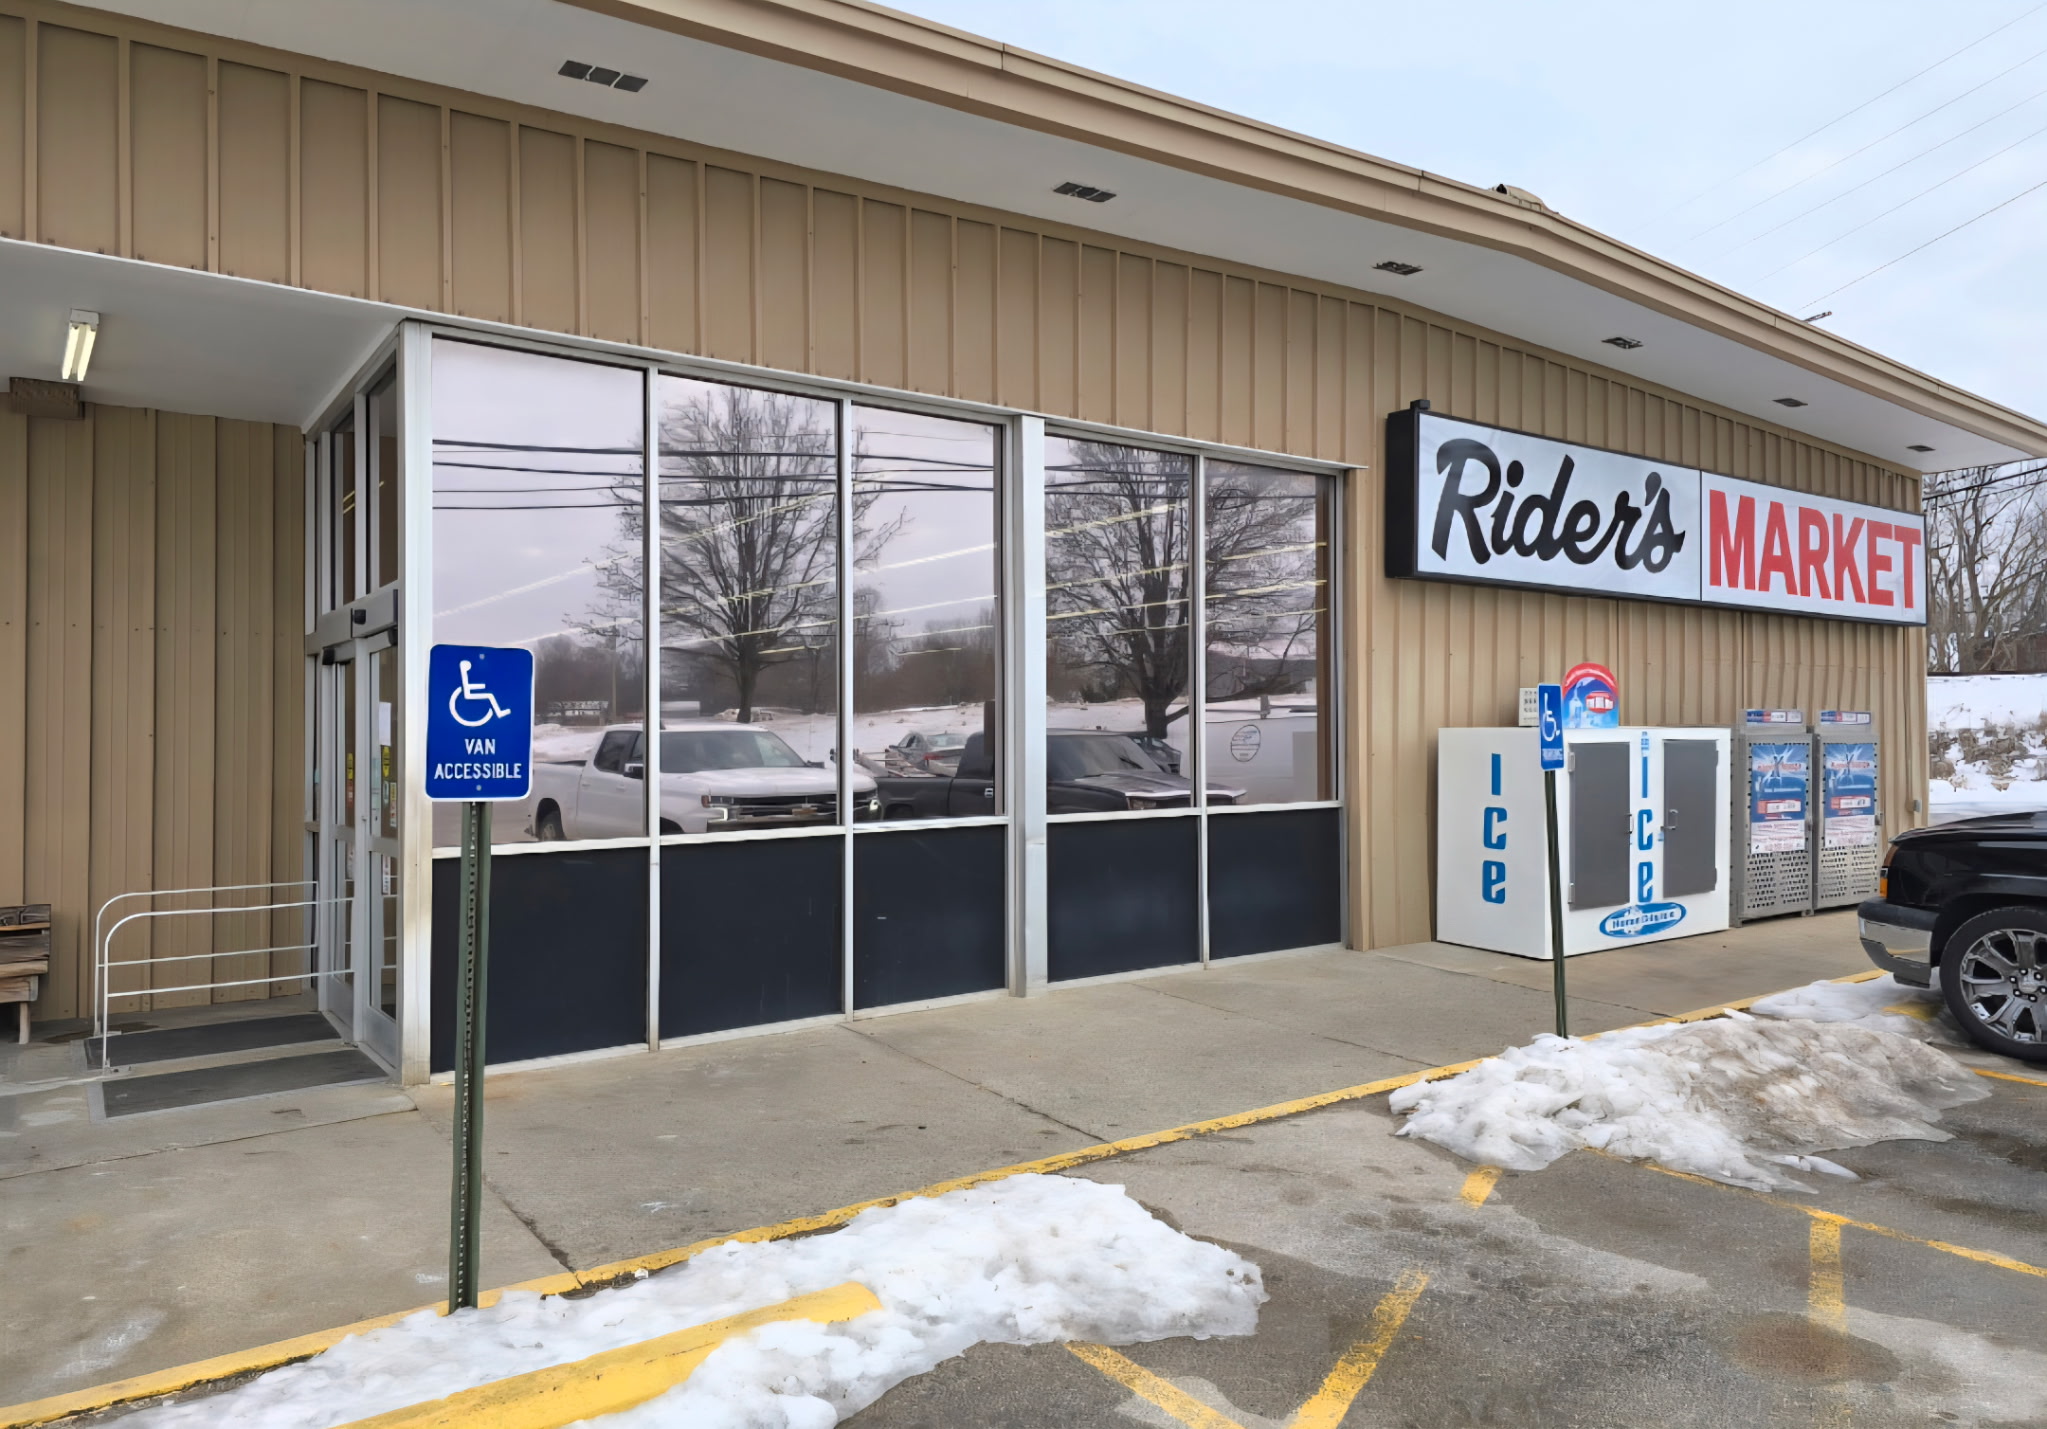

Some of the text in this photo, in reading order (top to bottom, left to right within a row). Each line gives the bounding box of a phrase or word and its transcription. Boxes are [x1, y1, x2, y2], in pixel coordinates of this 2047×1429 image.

[1431, 437, 1922, 610] Rider's MARKET
[464, 738, 496, 755] VAN
[433, 762, 522, 780] ACCESSIBLE
